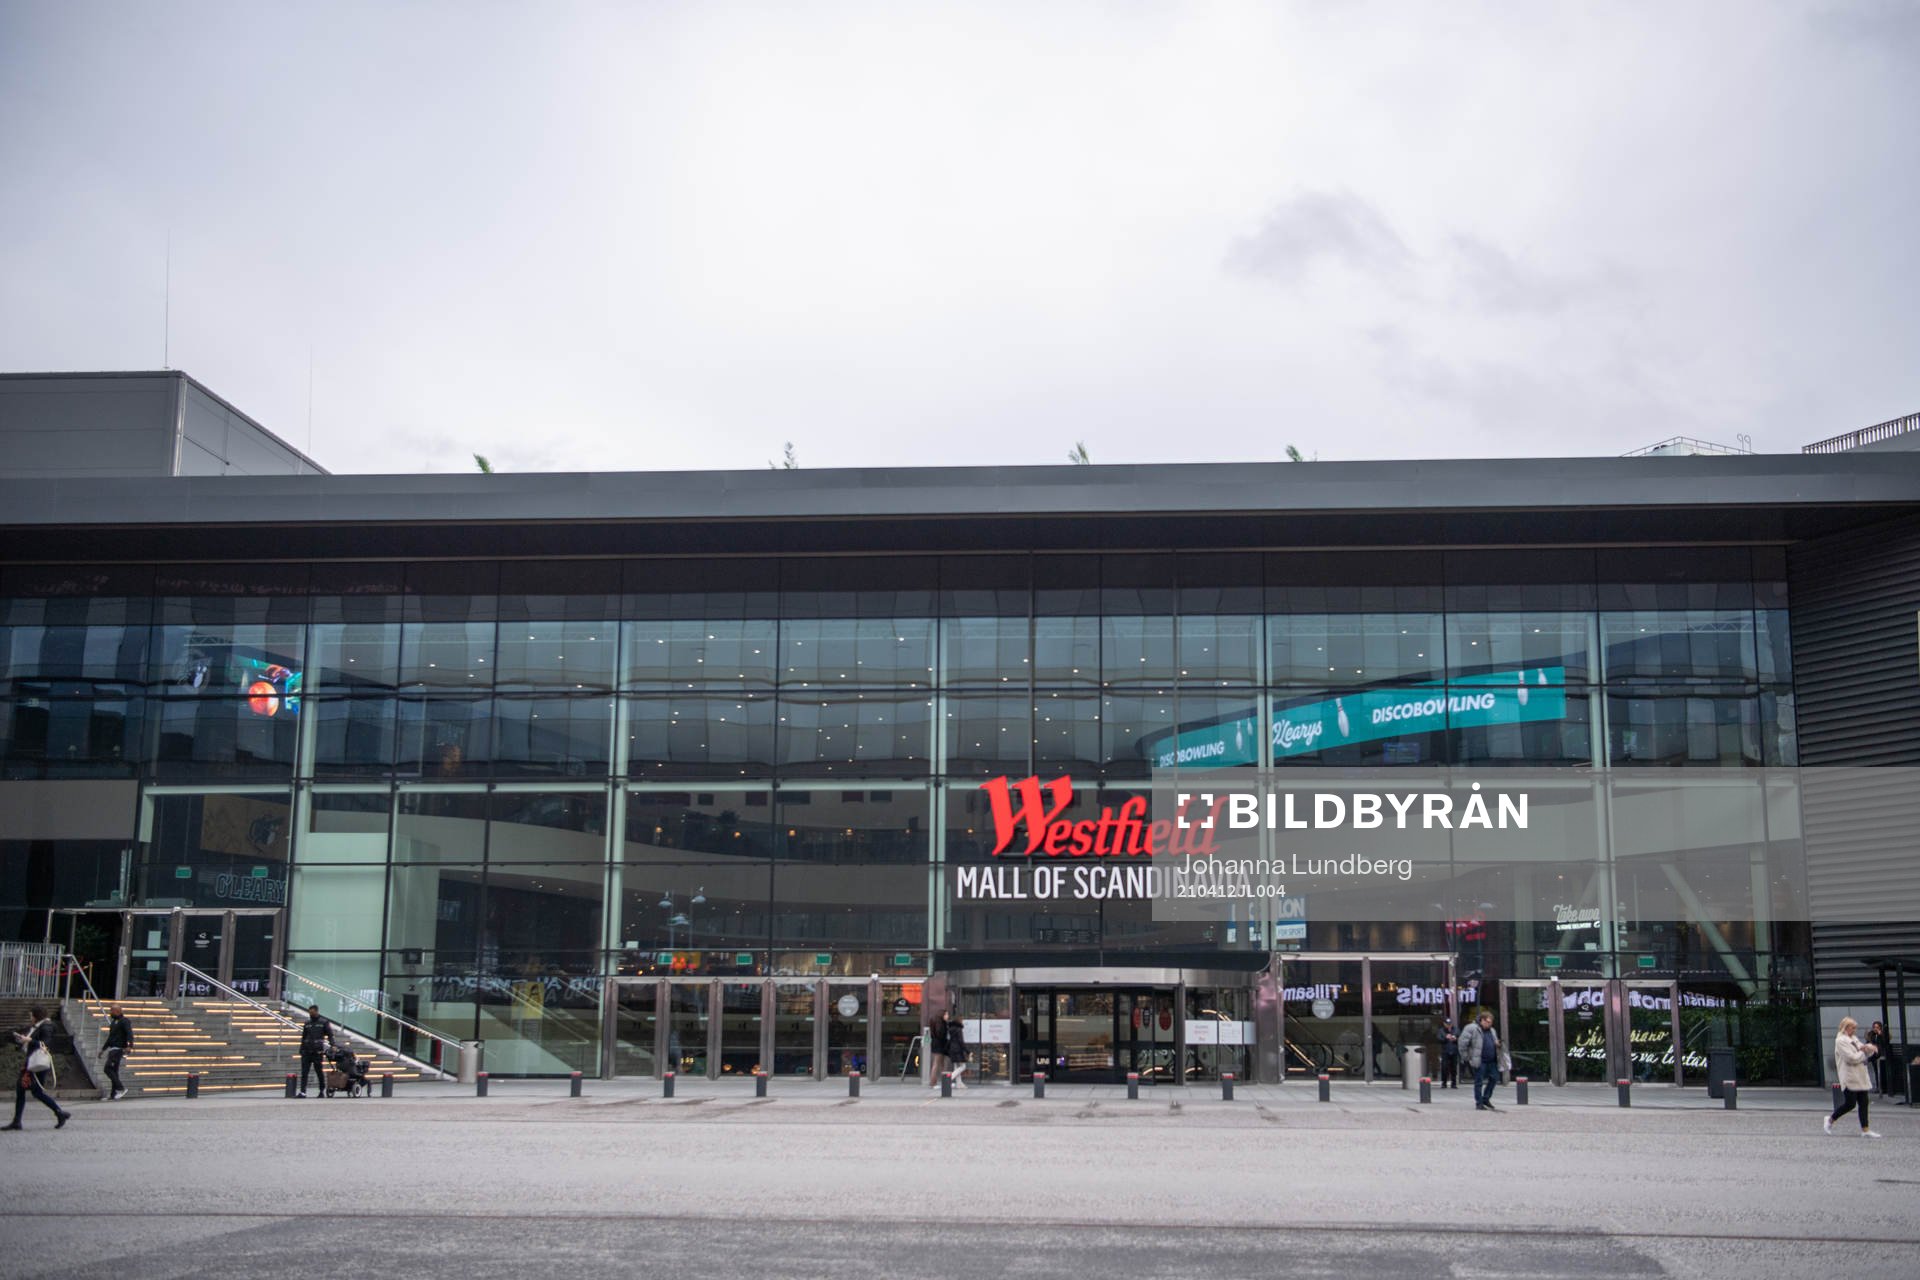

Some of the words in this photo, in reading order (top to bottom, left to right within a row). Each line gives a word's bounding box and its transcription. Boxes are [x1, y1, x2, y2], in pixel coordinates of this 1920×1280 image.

[1372, 692, 1495, 724] DISCOBOWLING
[1271, 717, 1322, 749] O'Learys
[979, 774, 1229, 857] Westfield
[957, 866, 1027, 899] MALL
[1034, 866, 1066, 899] OF
[1073, 865, 1250, 899] SCANDINAVIA
